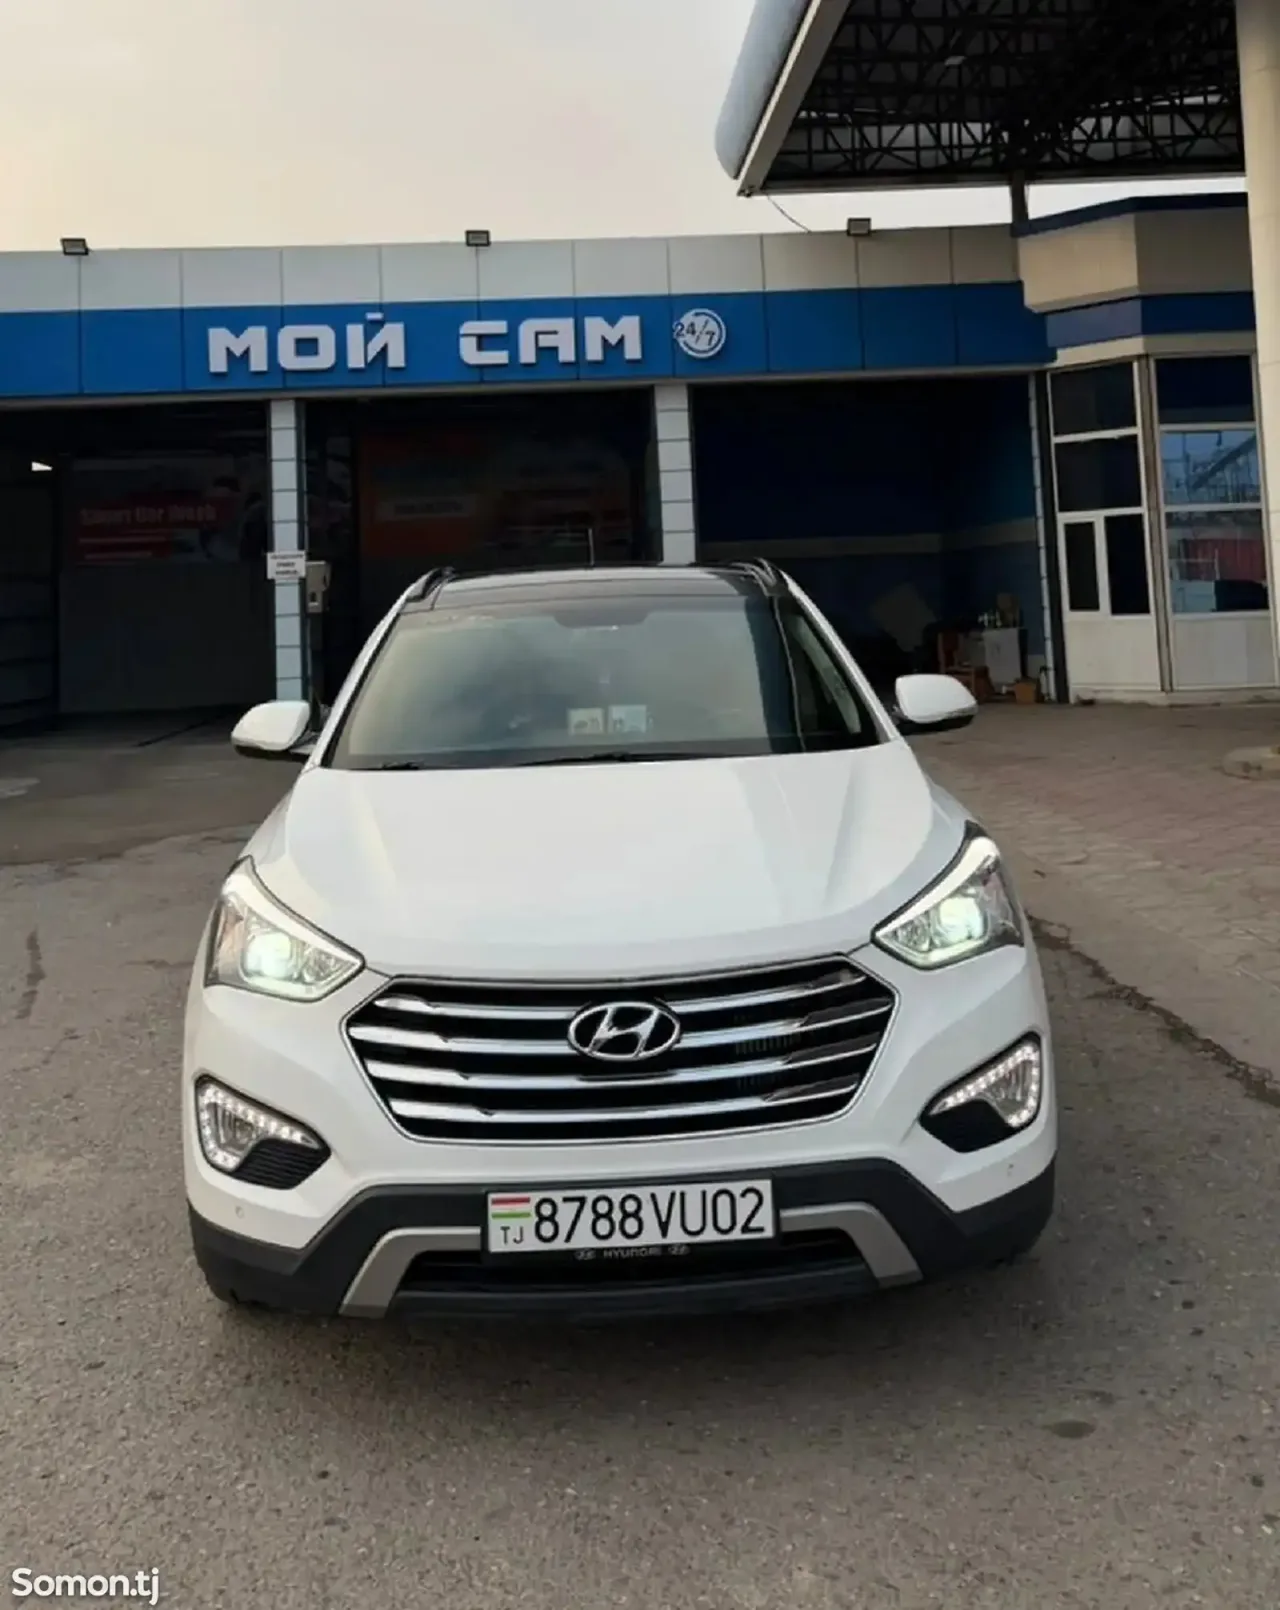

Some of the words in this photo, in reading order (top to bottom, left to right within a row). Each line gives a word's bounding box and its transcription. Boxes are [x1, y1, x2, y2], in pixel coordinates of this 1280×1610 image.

[208, 312, 406, 374] МОЙ
[459, 315, 642, 366] САМ
[673, 319, 715, 345] 24/7
[500, 1226, 524, 1244] TJ
[534, 1187, 765, 1244] 8788VU02
